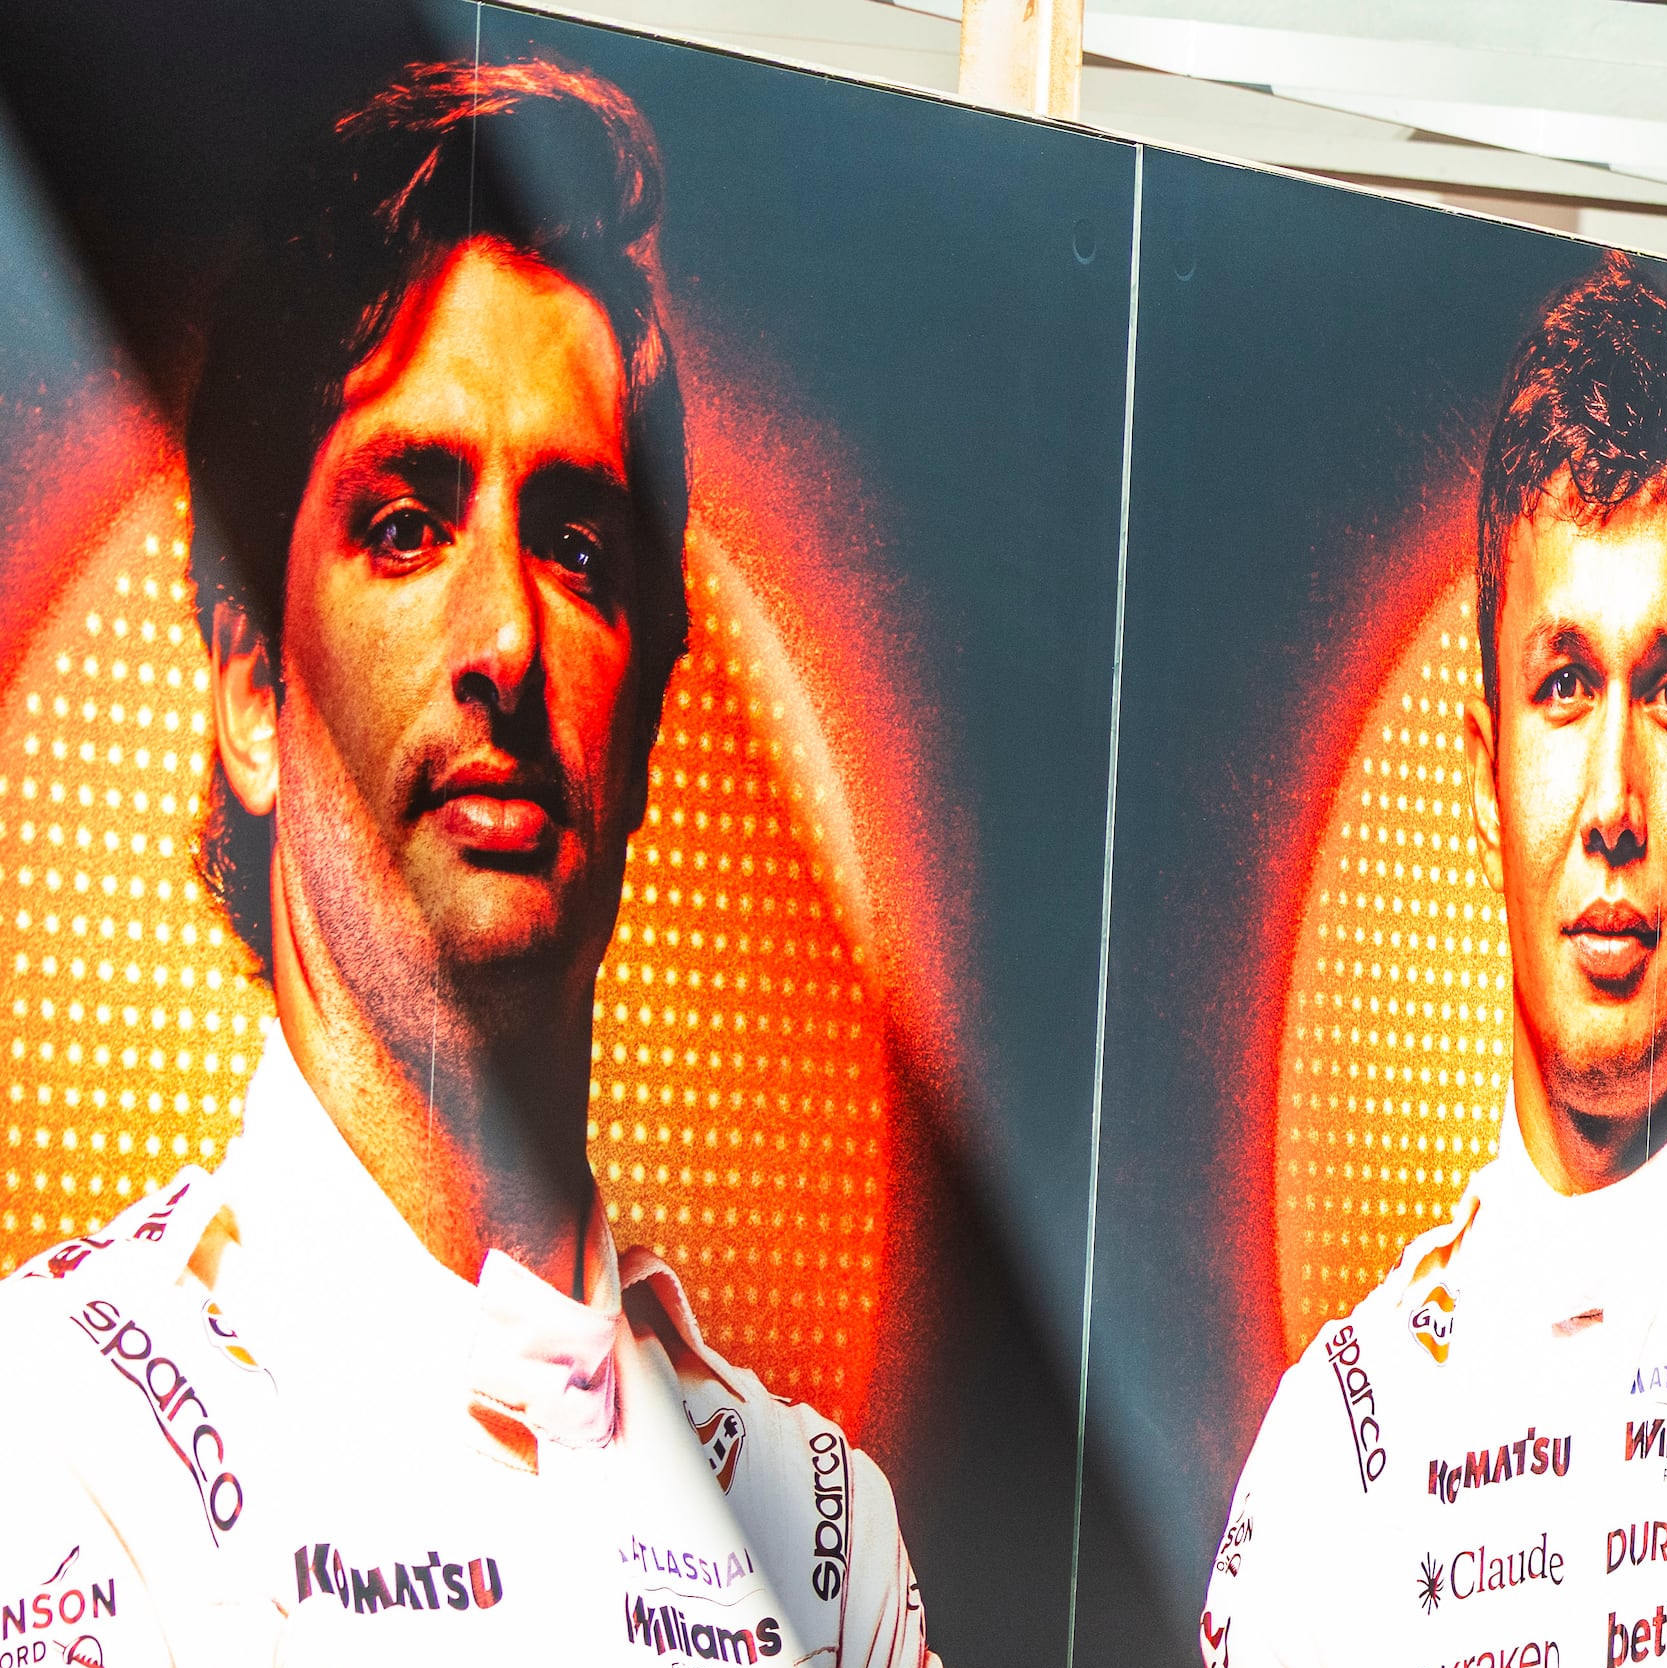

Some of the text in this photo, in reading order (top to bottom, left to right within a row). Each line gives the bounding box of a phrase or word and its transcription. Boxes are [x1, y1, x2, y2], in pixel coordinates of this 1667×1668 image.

[78, 1298, 244, 1534] sparco
[1326, 1325, 1387, 1483] sparco
[1427, 1426, 1572, 1505] KOMATSU
[808, 1432, 846, 1602] sparco
[294, 1542, 504, 1615] KOMATSU
[1450, 1532, 1565, 1600] Claude
[625, 1591, 782, 1666] Williams
